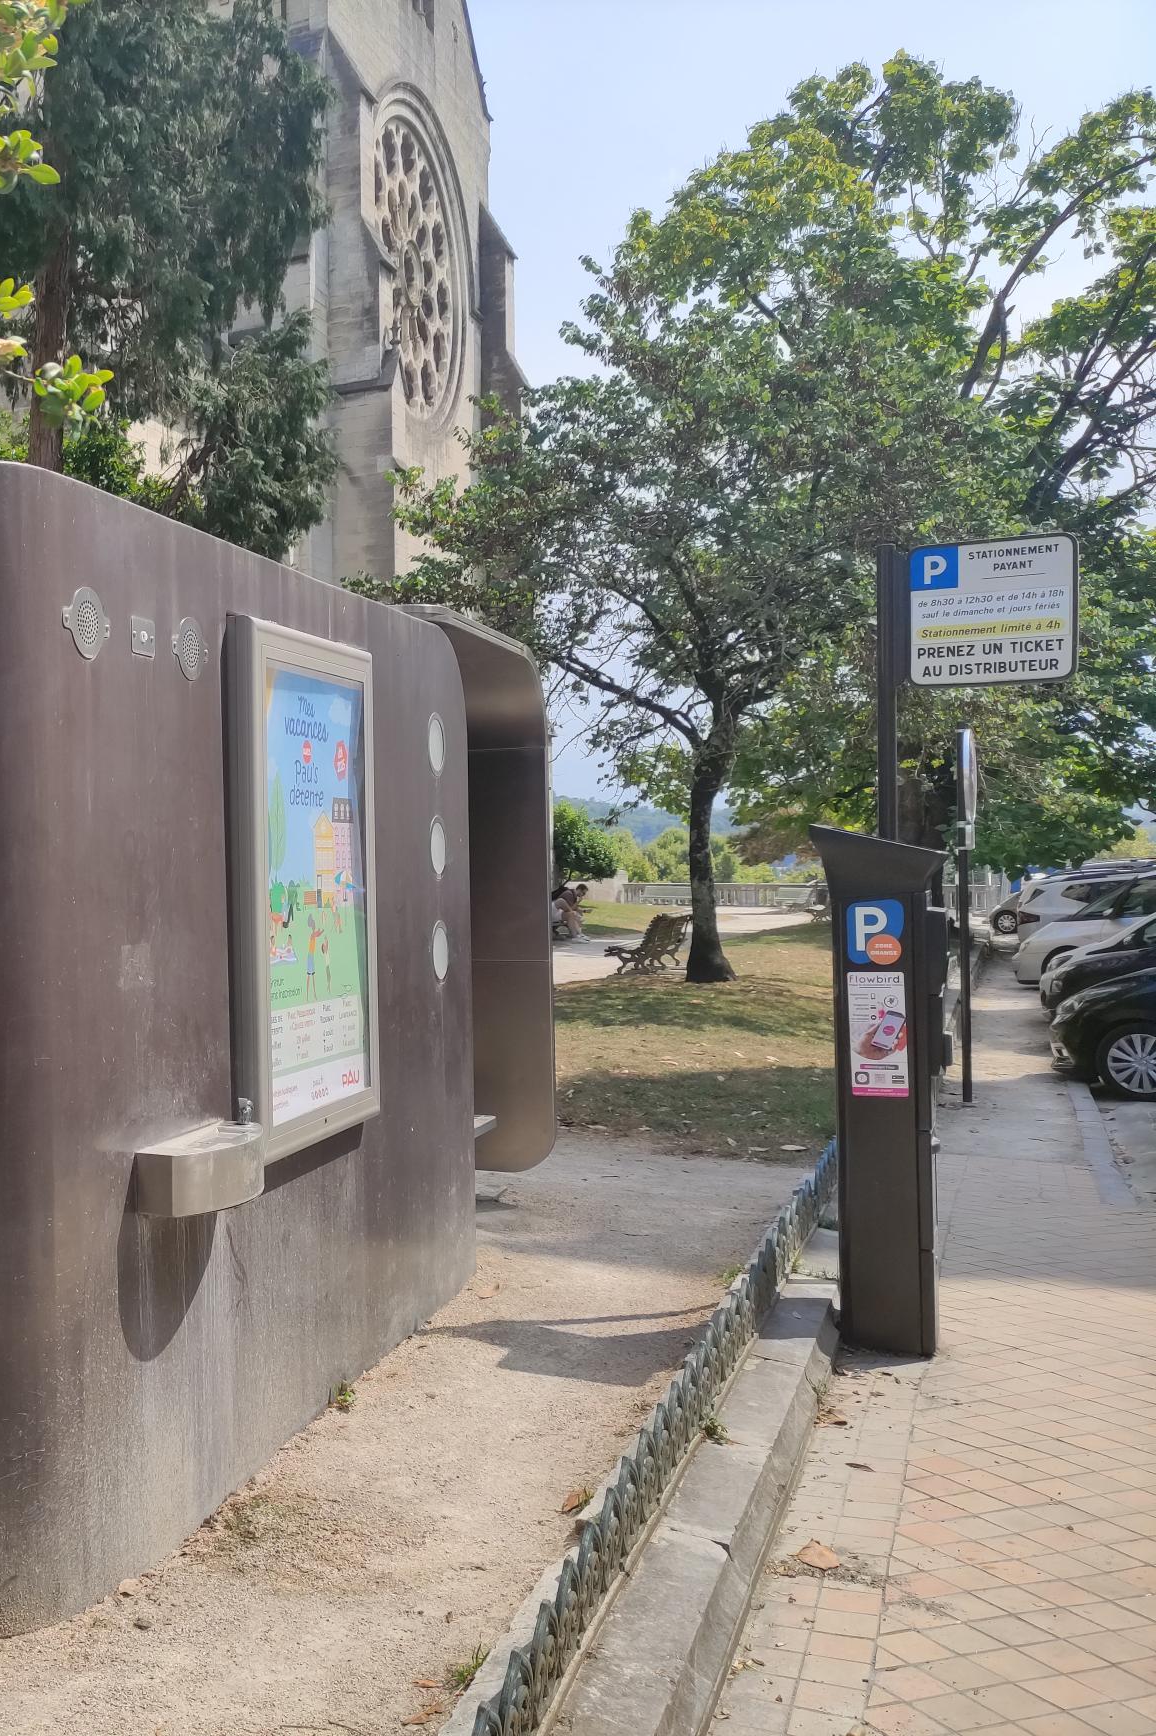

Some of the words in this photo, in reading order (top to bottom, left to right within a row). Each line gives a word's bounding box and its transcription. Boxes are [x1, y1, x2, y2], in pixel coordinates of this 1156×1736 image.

[968, 544, 1059, 560] STATIONNEMENT
[923, 555, 947, 585] P
[993, 560, 1034, 572] PAYANT
[917, 600, 928, 608] de
[930, 597, 955, 607] 8h30
[965, 594, 993, 604] 12h30
[1007, 593, 1019, 601] de
[1021, 591, 1037, 600] 14h
[1048, 589, 1064, 598] 18h
[921, 610, 939, 619] sauf
[942, 609, 950, 618] le
[953, 606, 994, 617] dimanche
[996, 606, 1005, 614] et
[1008, 604, 1032, 615] jours
[921, 624, 997, 638] Stationnement
[1000, 622, 1032, 633] limité
[1035, 621, 1042, 631] à
[1046, 620, 1061, 631] 4h
[917, 644, 976, 660] PRENEZ
[982, 642, 1003, 655] UN
[1010, 638, 1064, 653] TICKET
[922, 664, 943, 678] AU
[948, 658, 1060, 677] DISTRIBUTEUR
[297, 695, 315, 717] Mes
[284, 716, 329, 743] vacances
[294, 759, 319, 785] Pau's
[289, 783, 324, 807] détente
[855, 906, 887, 951] P
[849, 975, 900, 984] flowbird
